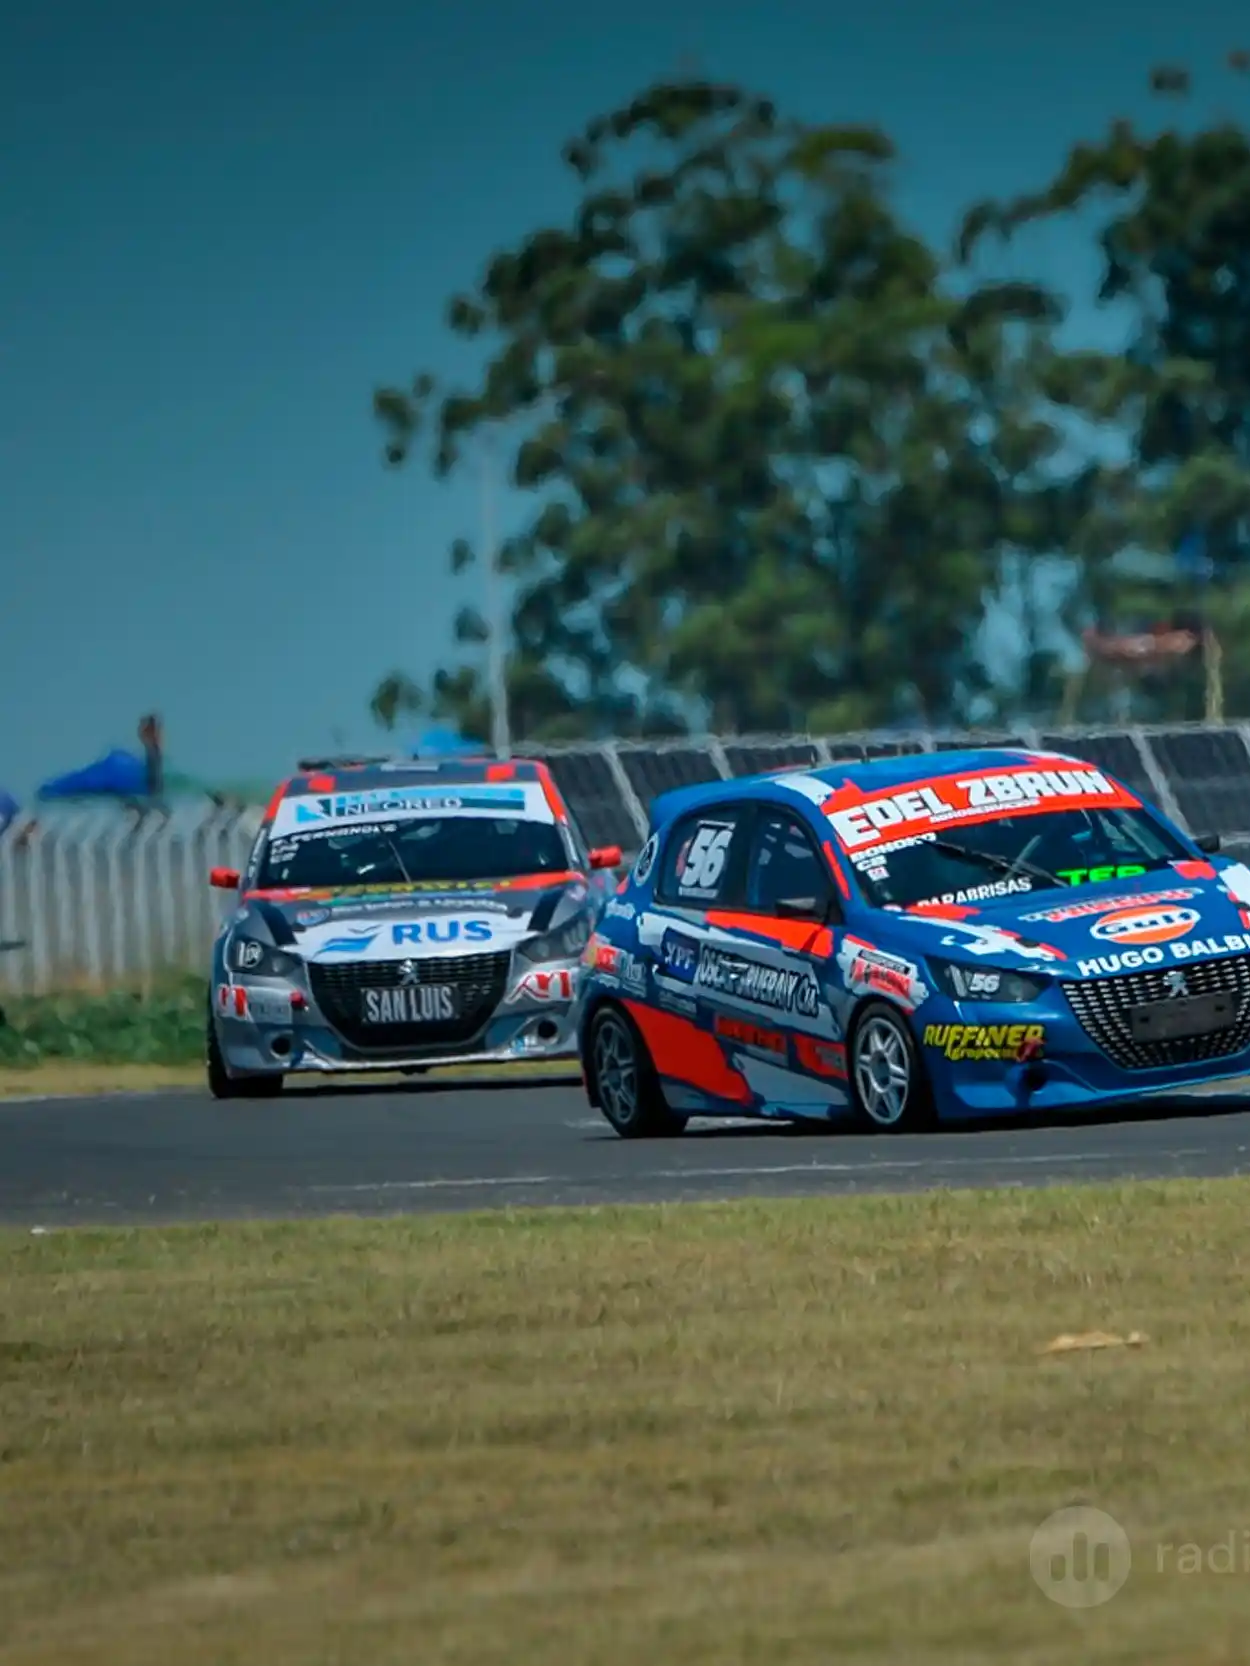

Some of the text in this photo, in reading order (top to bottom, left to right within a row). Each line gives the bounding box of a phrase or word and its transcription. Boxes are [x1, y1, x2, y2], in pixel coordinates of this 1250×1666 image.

[827, 787, 953, 848] EDEL
[681, 827, 734, 888] 56
[391, 920, 493, 945] RUS
[1078, 948, 1165, 977] HUGO
[970, 973, 1000, 993] 56
[366, 985, 453, 1023] SAN LUIS
[923, 1024, 1046, 1047] RUFFINER
